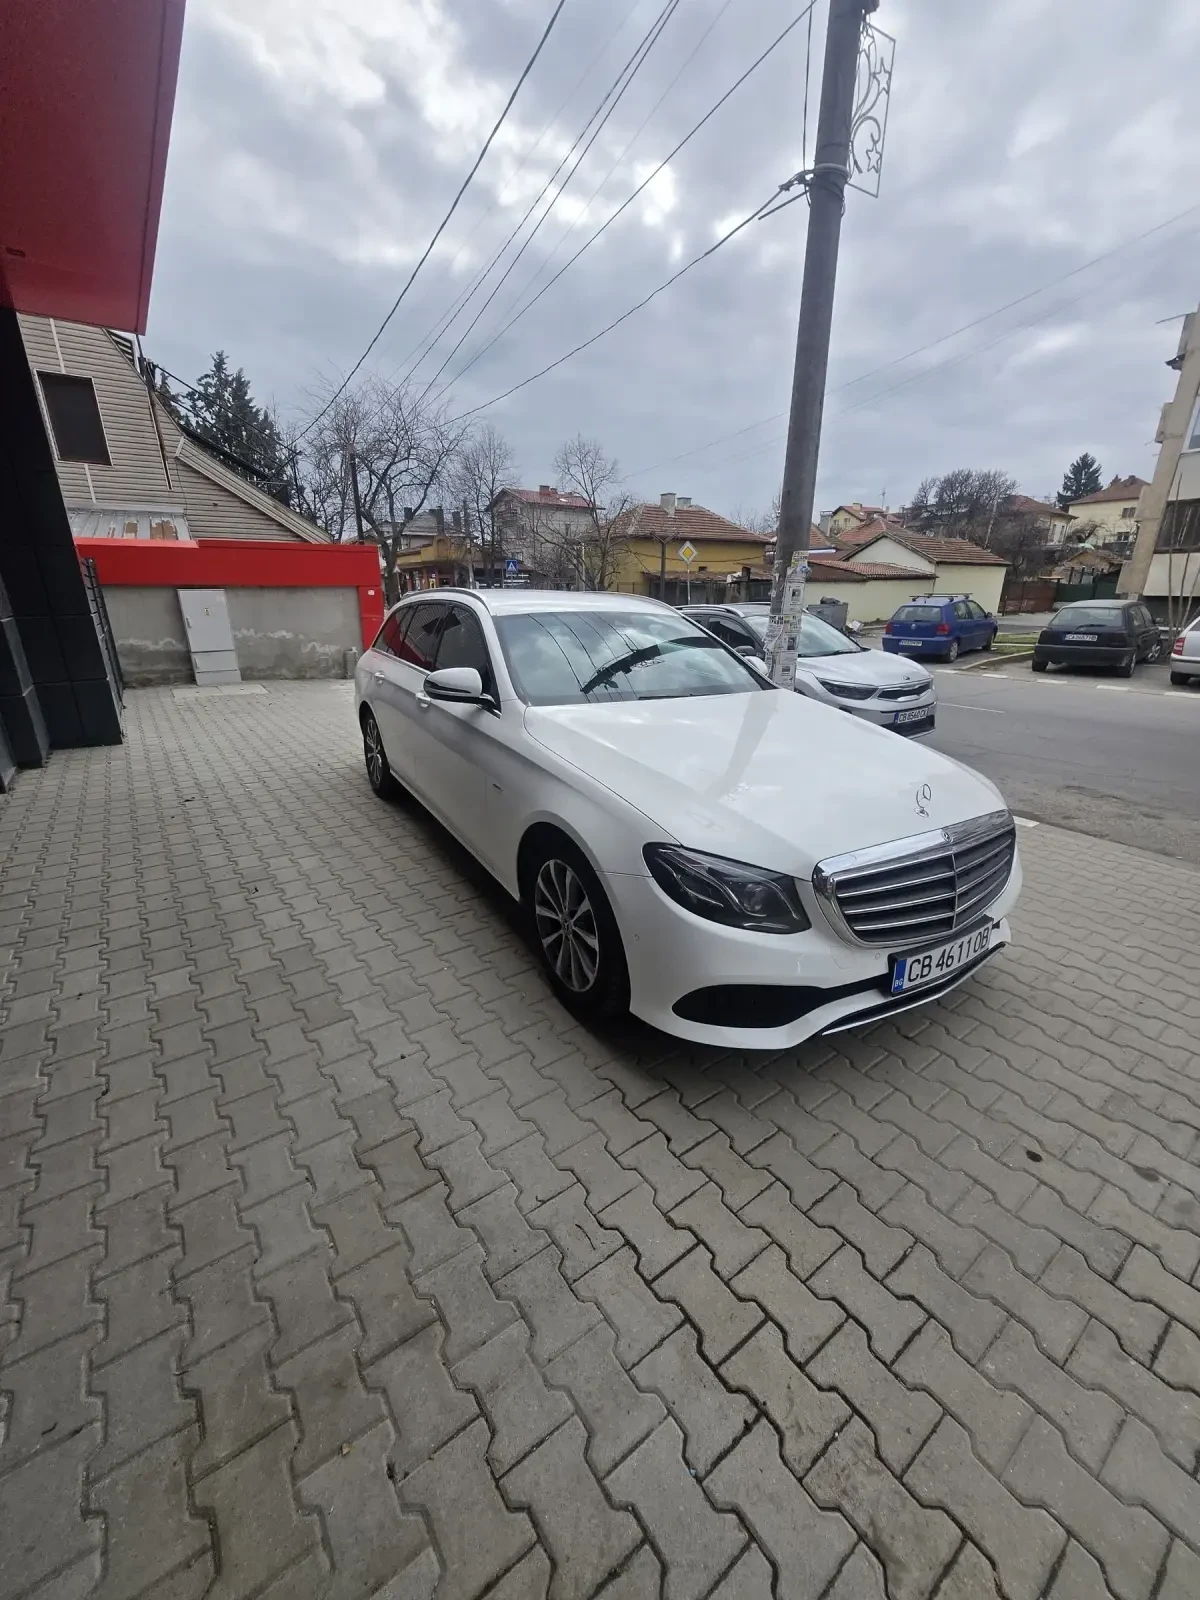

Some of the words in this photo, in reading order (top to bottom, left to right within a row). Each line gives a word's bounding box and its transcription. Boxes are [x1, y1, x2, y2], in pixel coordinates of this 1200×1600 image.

[907, 955, 932, 982] CB
[936, 937, 972, 971] 4611
[894, 978, 903, 987] BG
